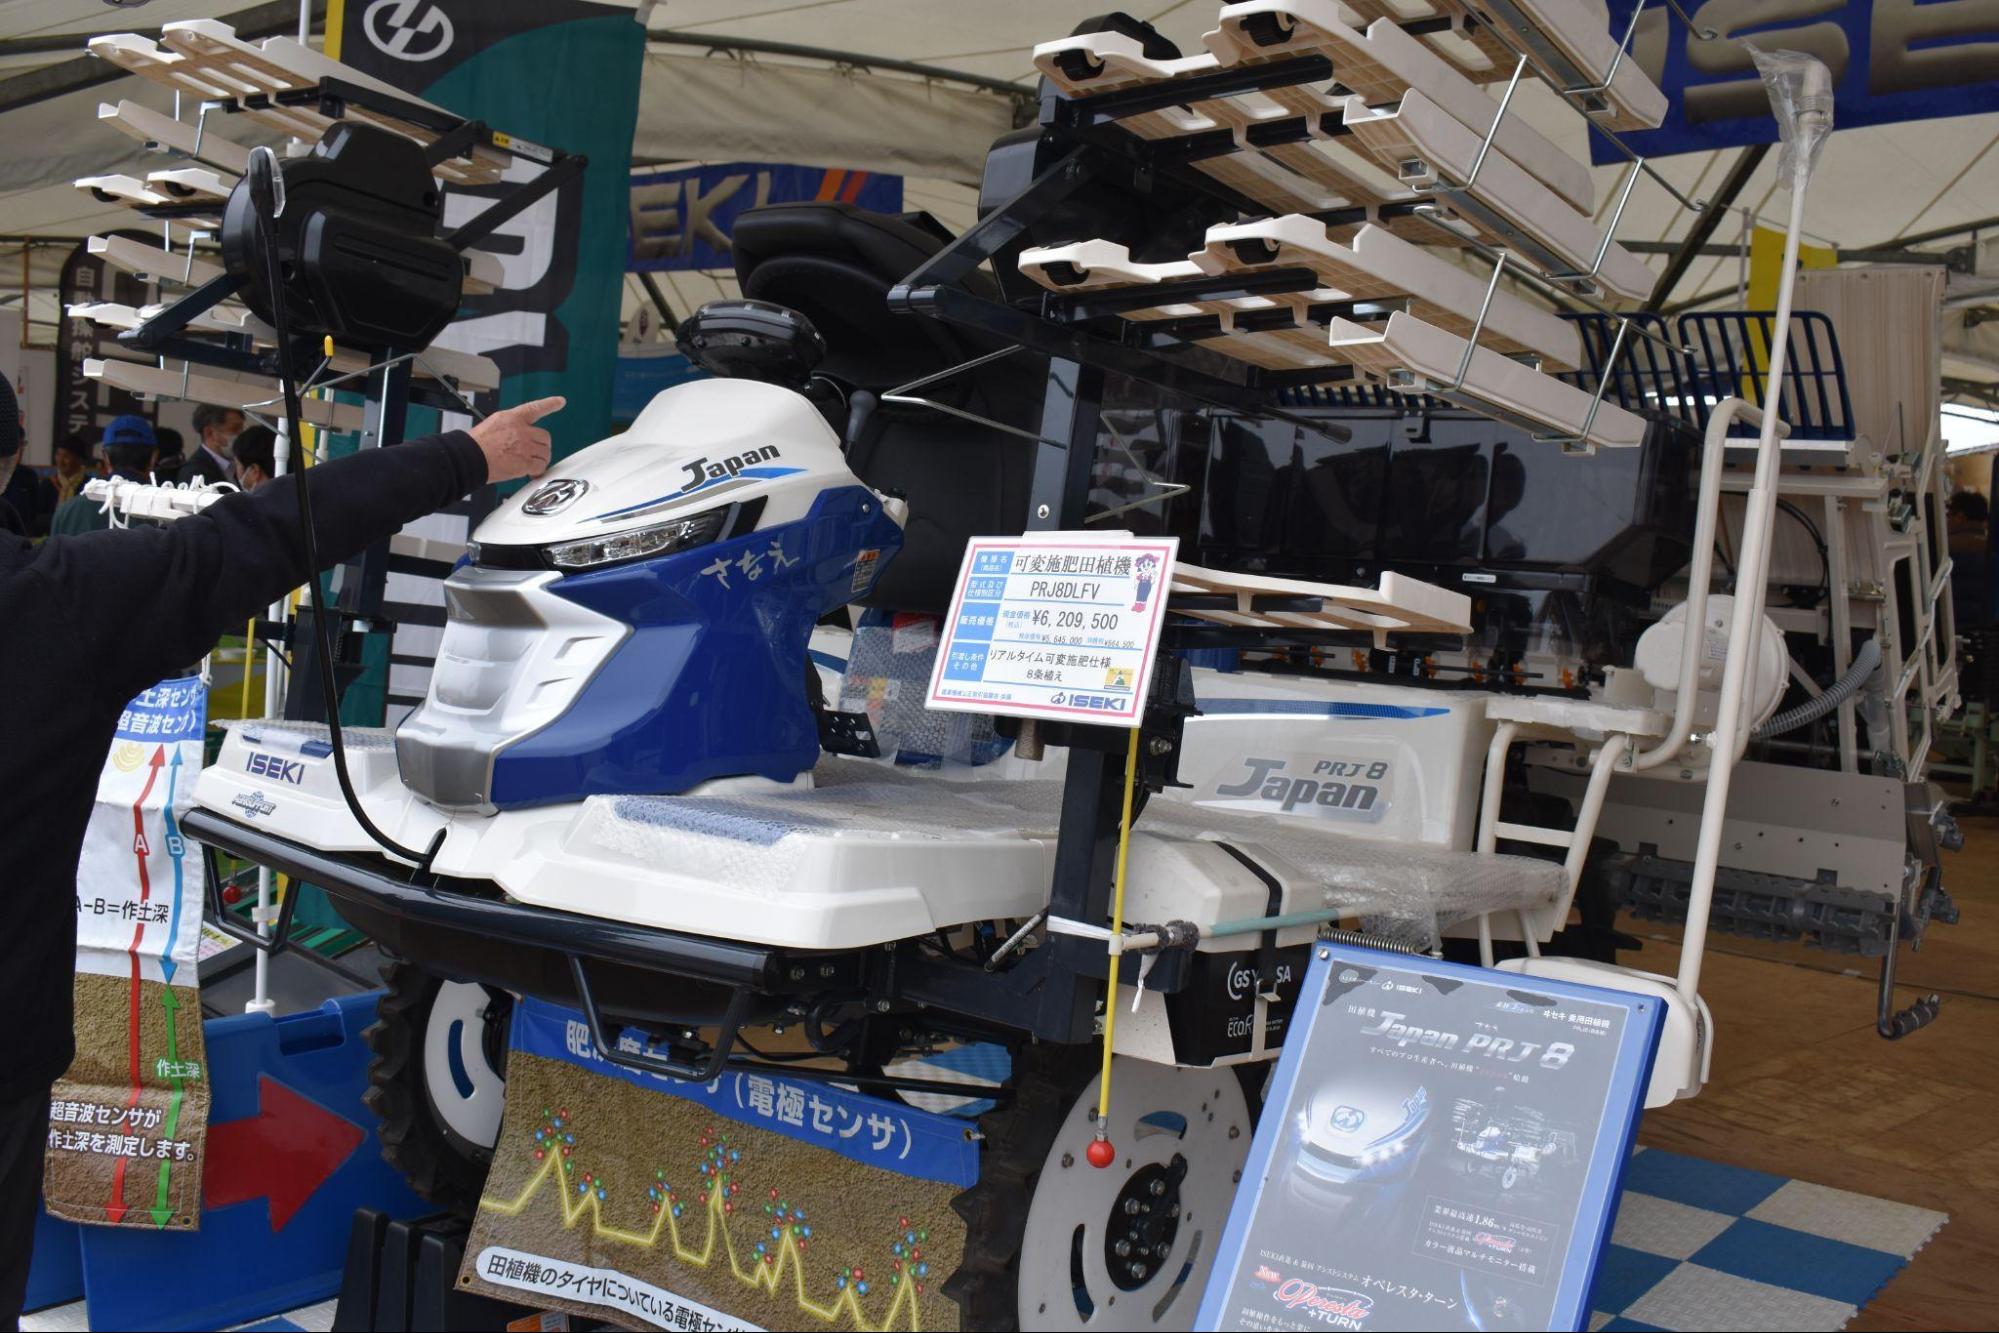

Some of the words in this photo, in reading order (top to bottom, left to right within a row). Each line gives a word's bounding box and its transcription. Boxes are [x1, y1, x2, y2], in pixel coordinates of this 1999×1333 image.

[681, 445, 780, 492] Japan
[701, 533, 800, 589] さなえ
[1015, 554, 1132, 576] 可変施肥田植機
[1030, 581, 1101, 600] PRJ8DLFV
[1032, 609, 1119, 631] ¥6,209,500
[990, 649, 1113, 669] リアルタイム可変施肥仕様
[1026, 669, 1063, 682] 8条植え
[1068, 694, 1126, 711] ISEKI
[246, 751, 306, 785] ISEKI
[1313, 760, 1366, 778] PRJ
[1365, 762, 1389, 780] 8
[1216, 757, 1378, 812] Japan
[134, 833, 149, 854] A
[168, 836, 184, 855] B
[1360, 1010, 1460, 1051] Japan
[1463, 1033, 1542, 1063] PRJ
[1539, 1042, 1575, 1070] 8
[157, 1058, 200, 1079] 作土深
[49, 1100, 162, 1129] 超音波センサが
[48, 1128, 196, 1161] 作土深を測定します。
[1361, 1275, 1459, 1311] オペレスタ・ターン
